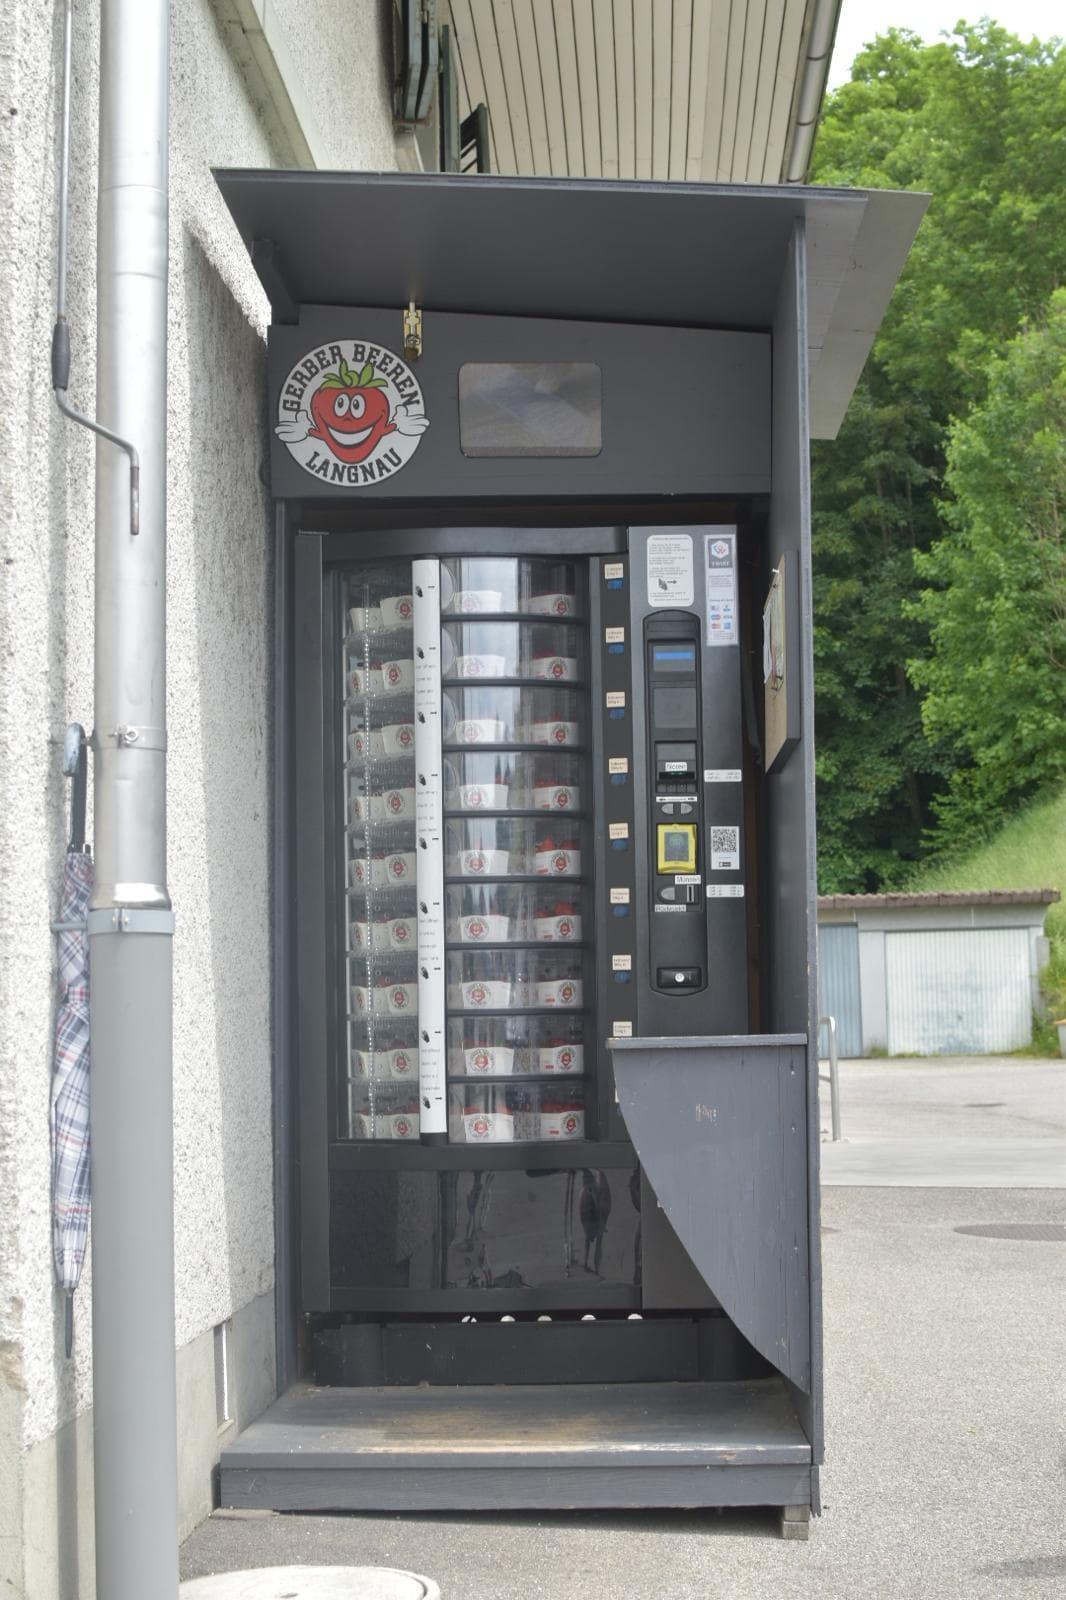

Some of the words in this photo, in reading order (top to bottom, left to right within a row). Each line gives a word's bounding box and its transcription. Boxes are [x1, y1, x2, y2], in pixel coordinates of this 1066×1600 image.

[282, 343, 344, 412] GERBER
[351, 343, 420, 406] BEEREN
[305, 447, 403, 484] LANGNAU
